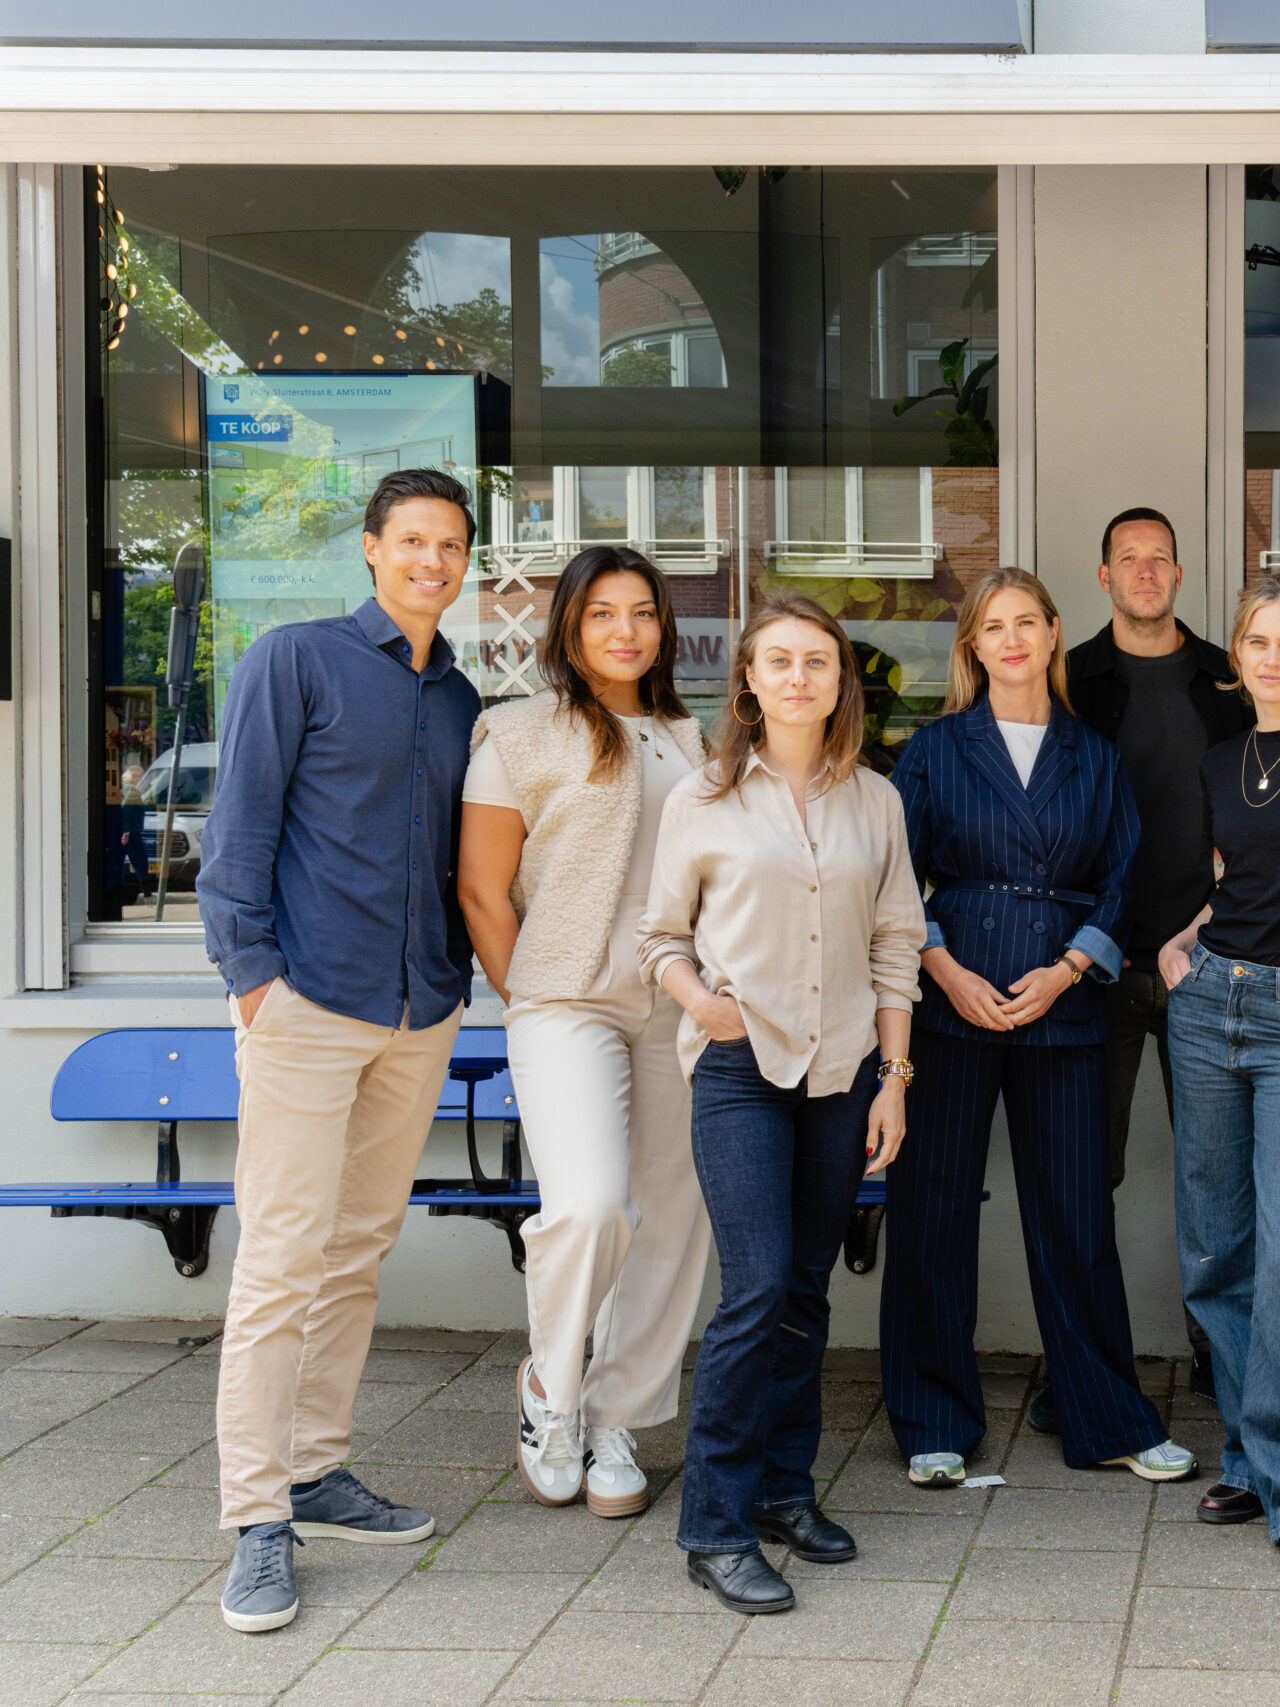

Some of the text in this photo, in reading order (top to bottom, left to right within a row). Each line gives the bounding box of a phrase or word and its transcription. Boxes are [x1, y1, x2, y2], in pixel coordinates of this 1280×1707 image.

[336, 388, 391, 396] AMSTERDAM
[219, 422, 281, 434] TE KOOP
